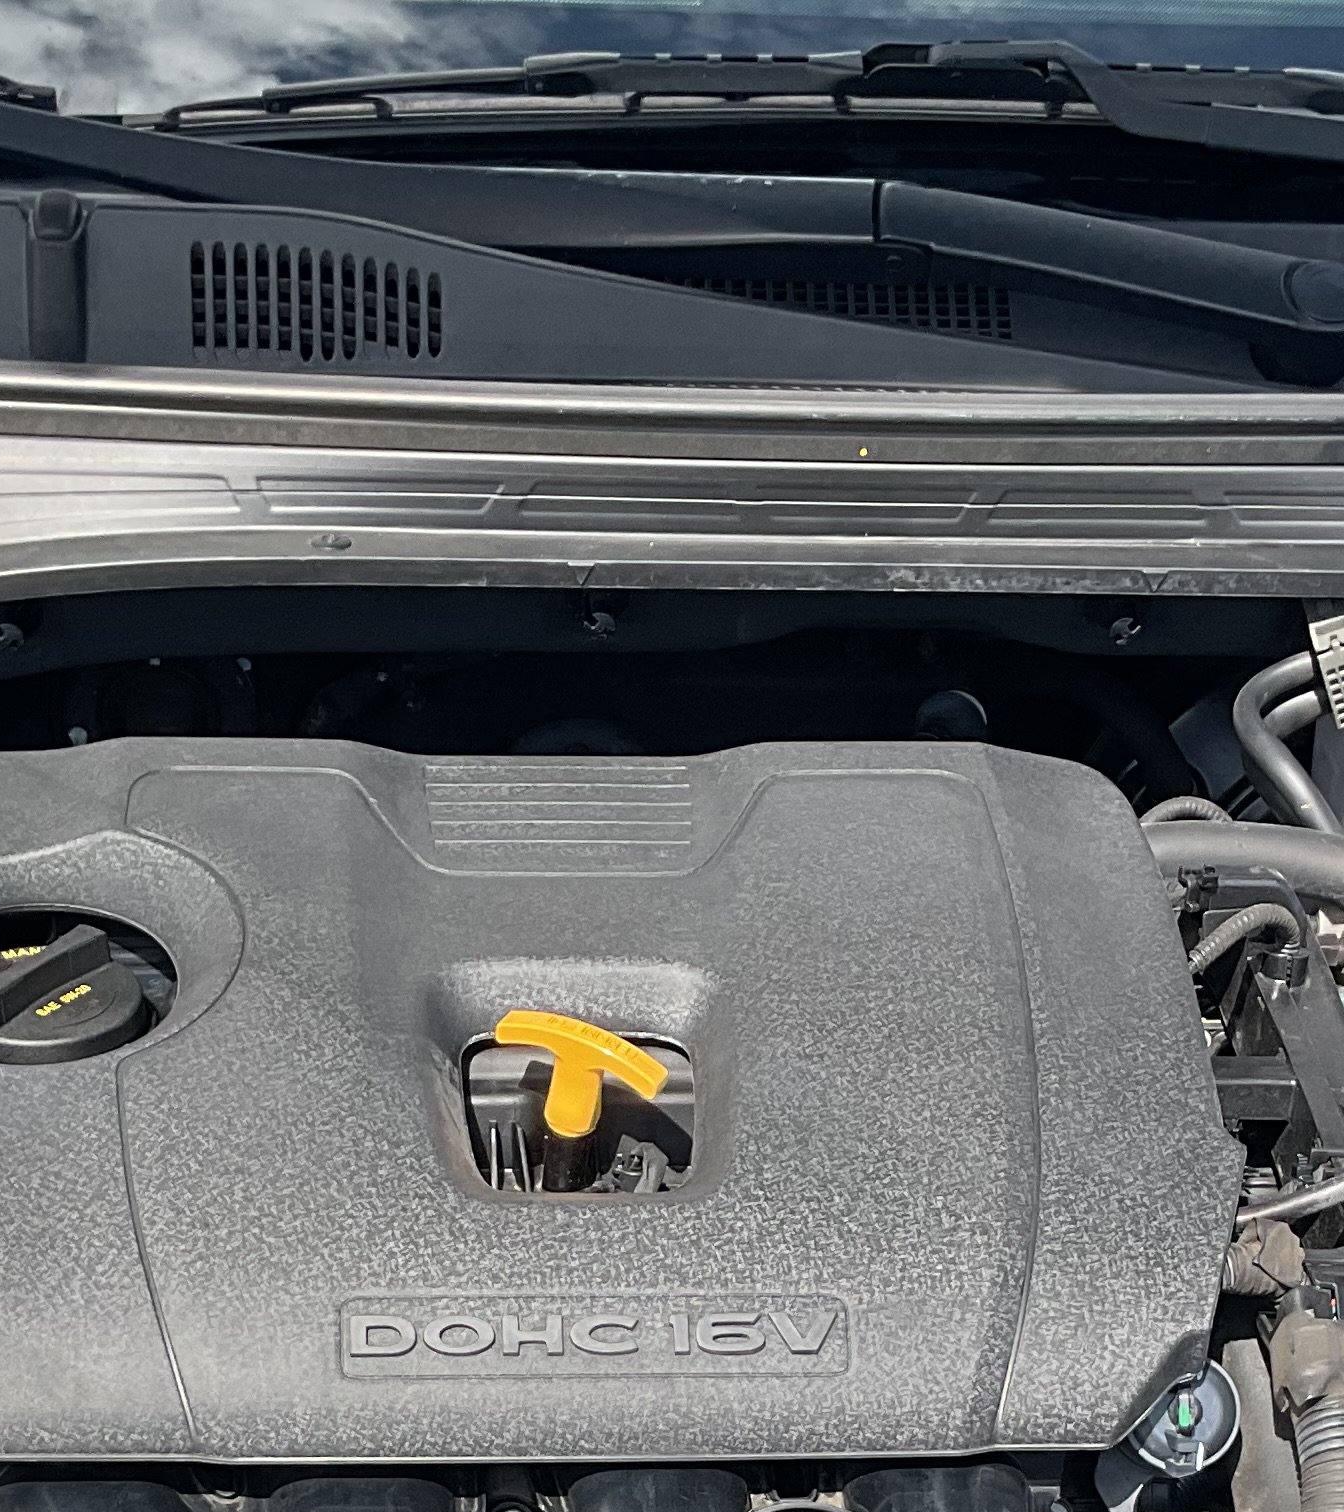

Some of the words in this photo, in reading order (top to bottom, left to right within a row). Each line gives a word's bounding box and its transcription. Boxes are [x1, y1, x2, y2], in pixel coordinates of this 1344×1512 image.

[35, 1000, 61, 1016] SAE
[348, 1314, 639, 1358] DOHC
[669, 1311, 839, 1356] 16V
